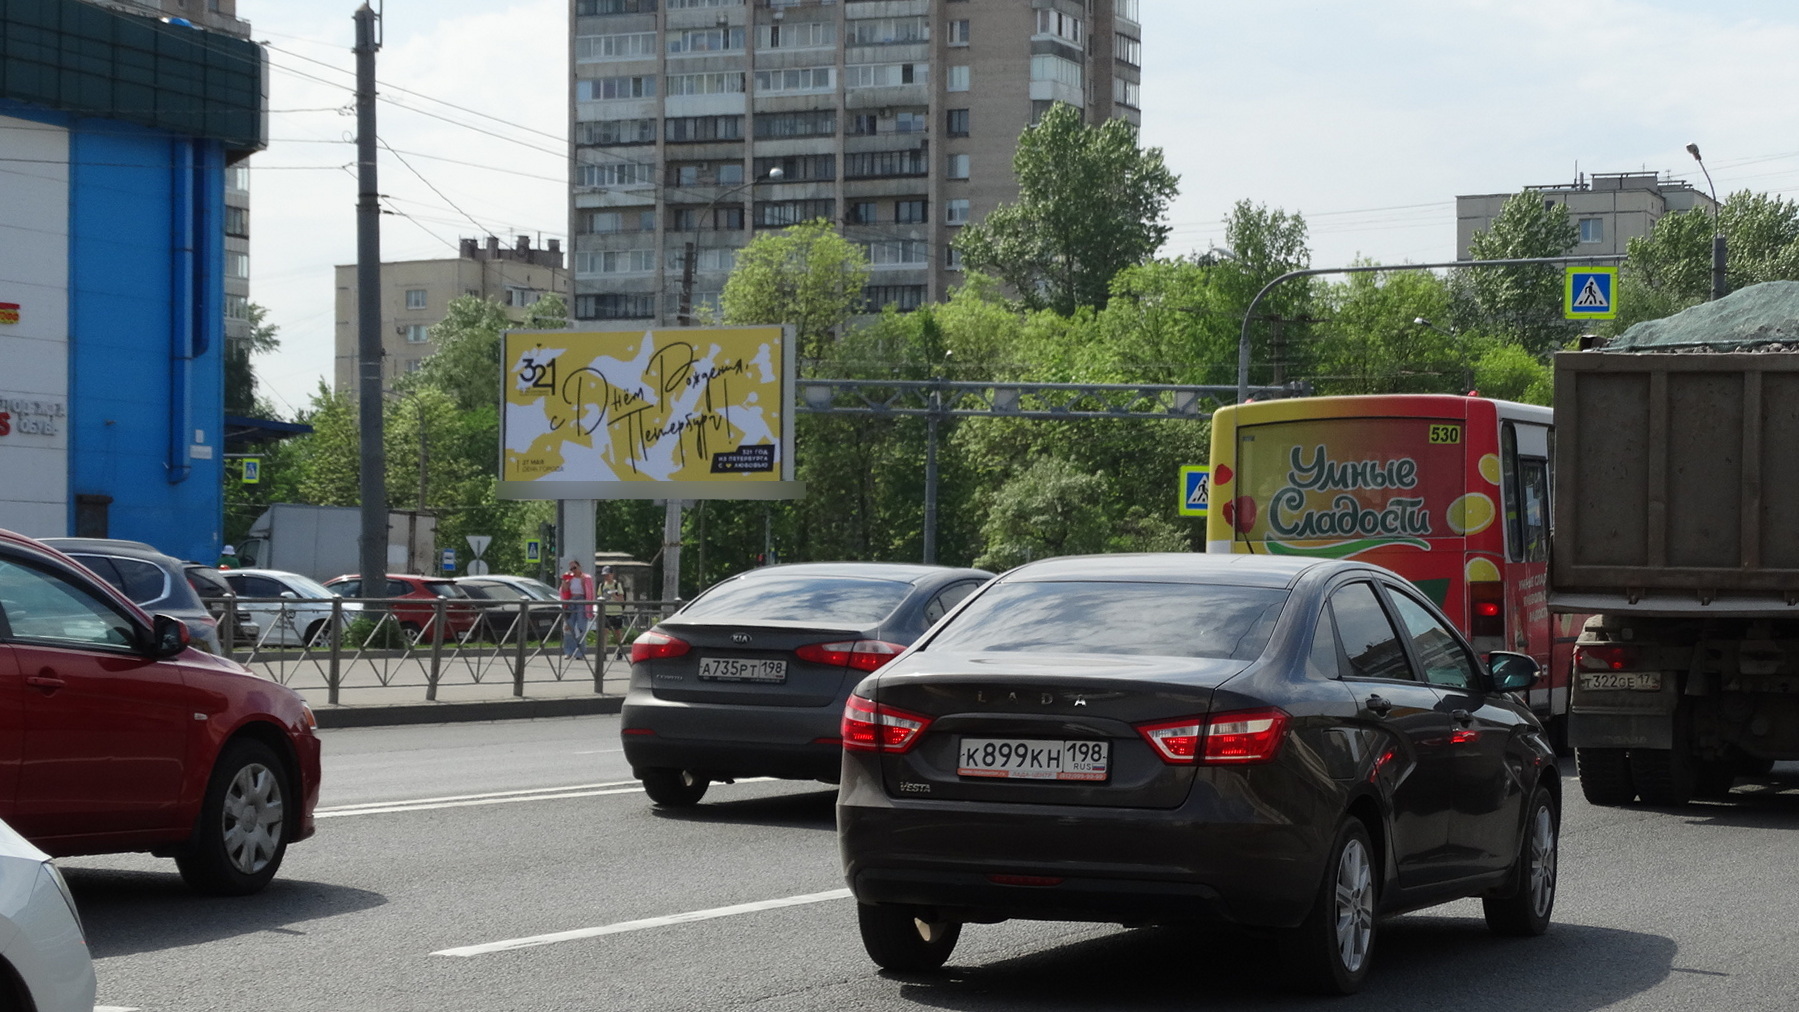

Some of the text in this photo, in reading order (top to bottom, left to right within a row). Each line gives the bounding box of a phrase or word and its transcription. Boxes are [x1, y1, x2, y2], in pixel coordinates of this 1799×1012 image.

[519, 358, 556, 396] 321
[1430, 426, 1459, 443] 530
[1288, 444, 1417, 490] Умные
[1268, 487, 1432, 537] Сладости
[731, 634, 750, 643] KIA
[702, 660, 758, 676] А735РТ
[761, 661, 783, 674] 198
[977, 690, 1088, 708] LADA
[966, 742, 1102, 769] К899КН 198
[1073, 763, 1092, 771] RUS
[899, 781, 931, 793] VESTA
